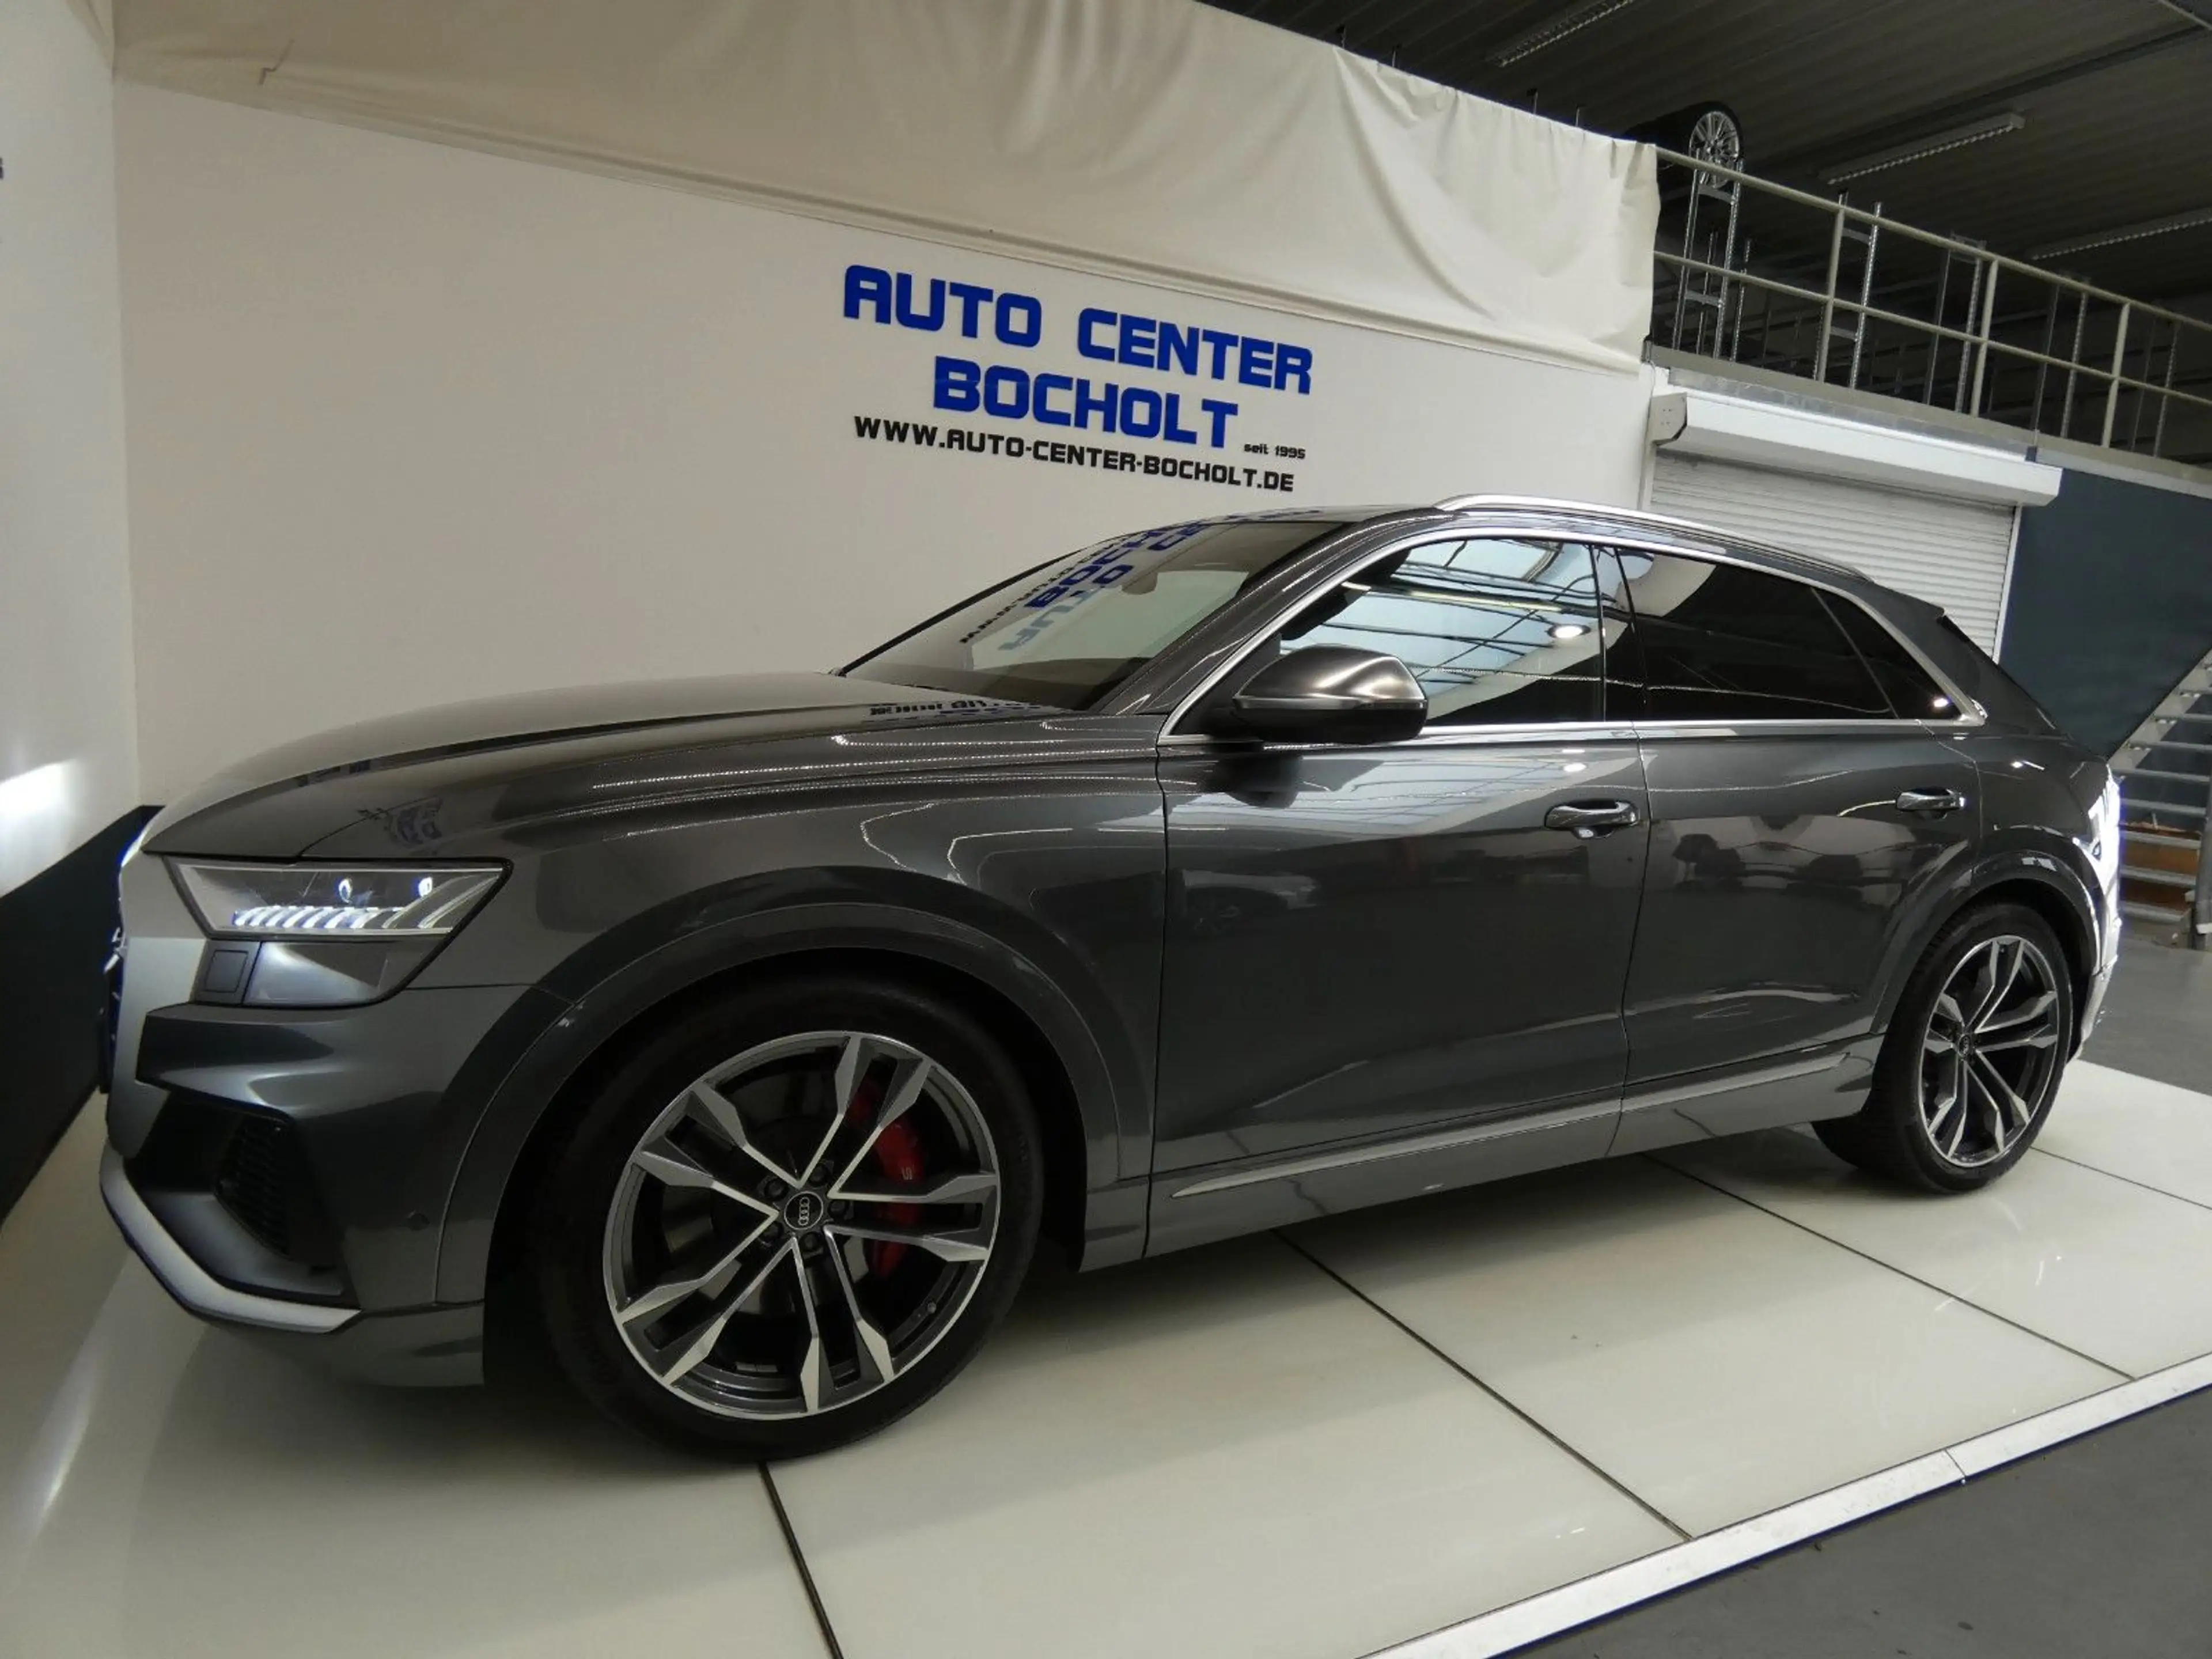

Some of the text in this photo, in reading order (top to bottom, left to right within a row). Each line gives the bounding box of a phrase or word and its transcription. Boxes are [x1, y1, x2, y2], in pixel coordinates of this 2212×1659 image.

[844, 265, 1313, 395] AUTO CENTER
[933, 355, 1239, 449] BOCHOLT
[854, 415, 1294, 492] WWW.AUTO-CENTER-BOCHOLT.DE
[1244, 443, 1306, 460] seit 1995
